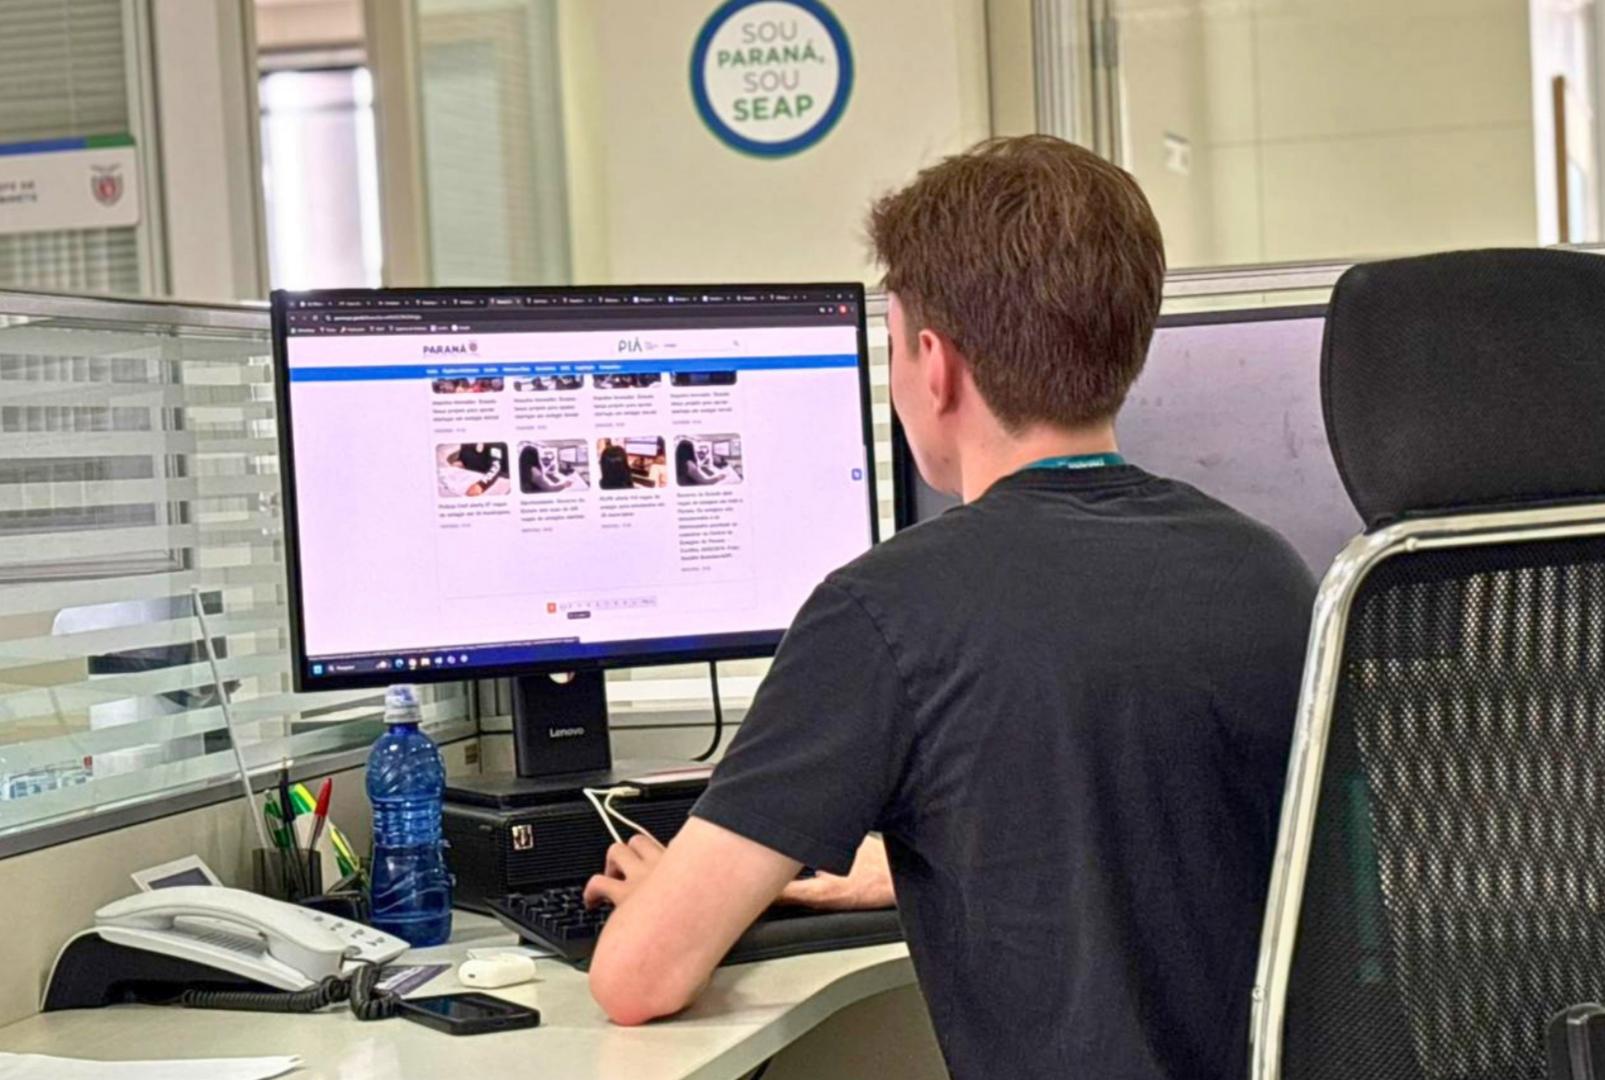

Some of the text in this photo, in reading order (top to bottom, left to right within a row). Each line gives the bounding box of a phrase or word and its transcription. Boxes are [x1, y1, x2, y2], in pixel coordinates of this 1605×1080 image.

[741, 20, 798, 44] SOU
[743, 70, 800, 93] SOU
[733, 94, 813, 121] SEAP
[549, 727, 585, 738] Lenovo
